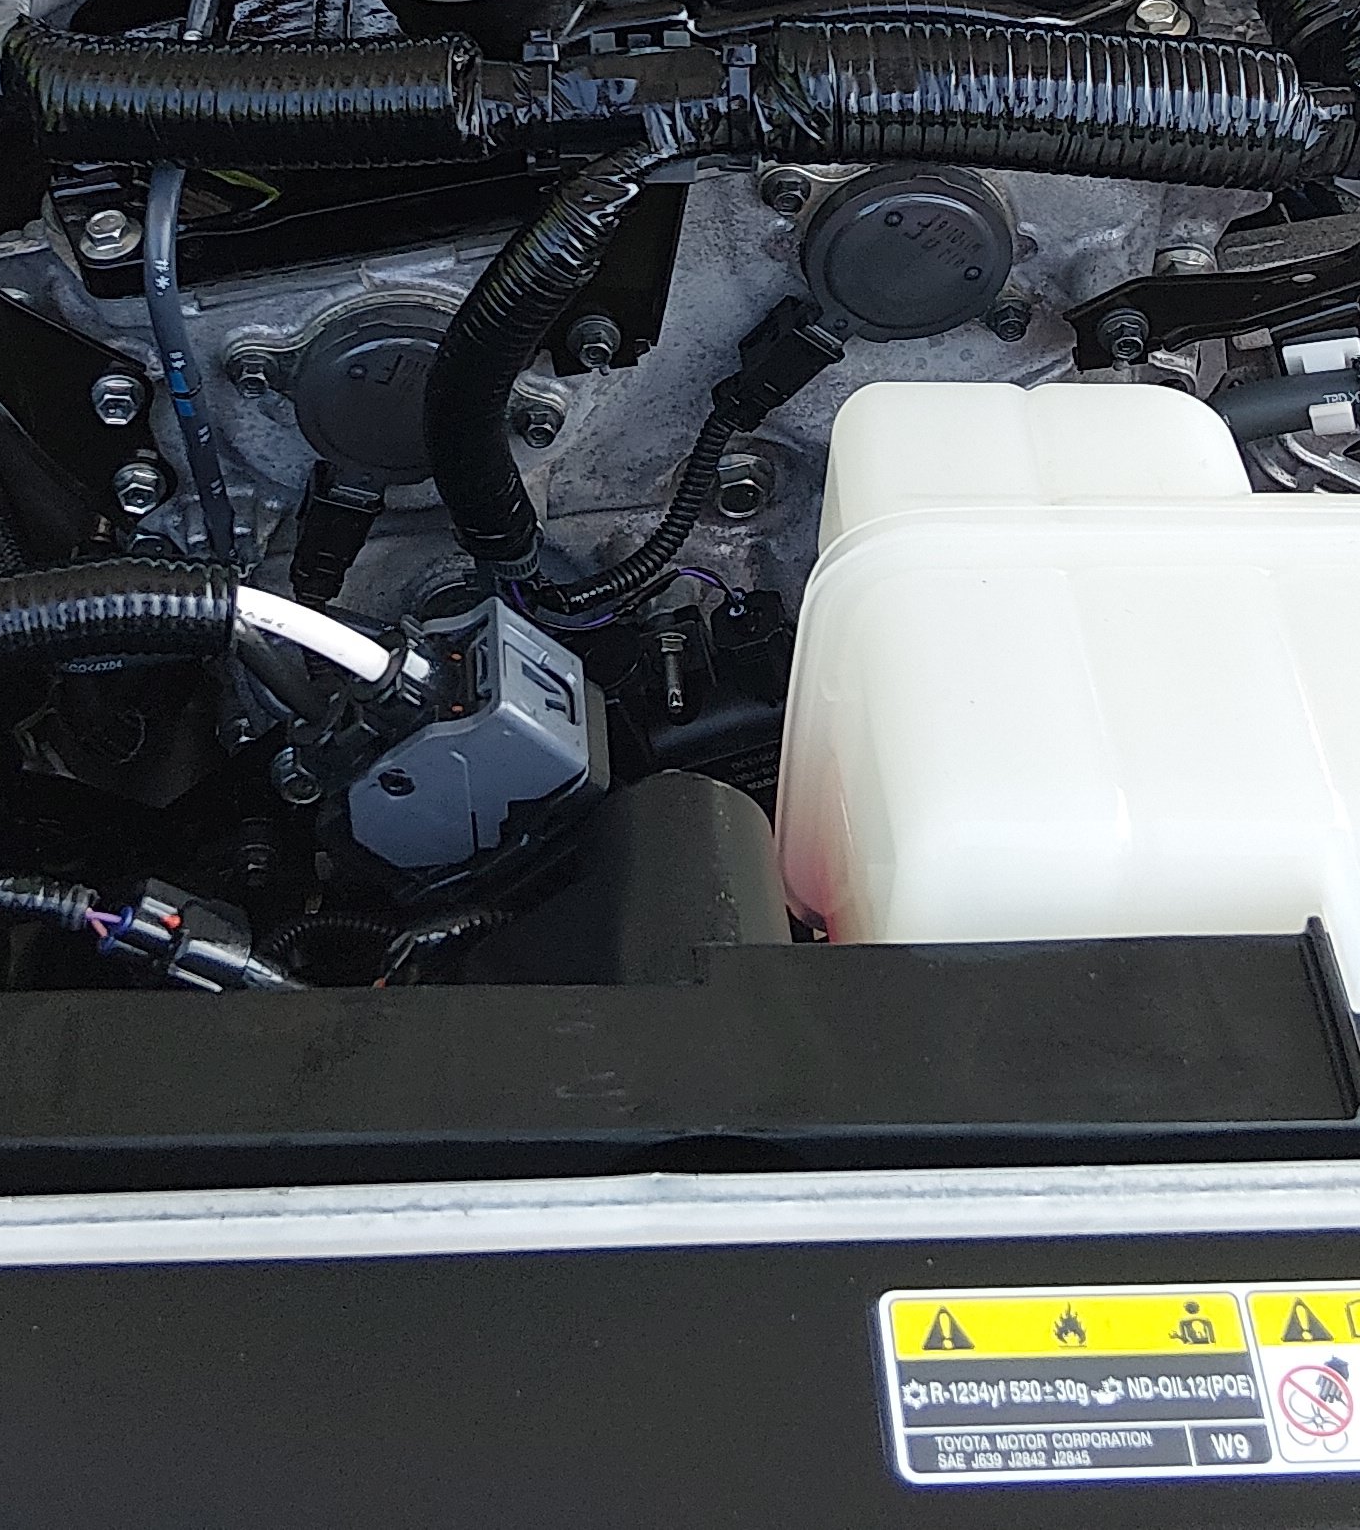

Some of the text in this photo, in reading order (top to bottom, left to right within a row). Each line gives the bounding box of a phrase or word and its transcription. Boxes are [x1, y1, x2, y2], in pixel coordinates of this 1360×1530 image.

[929, 1379, 1007, 1408] R-1234yf
[935, 1430, 1154, 1452] TOYOTA MOTOR CORPORATION
[1210, 1432, 1253, 1461] W9
[937, 1449, 1093, 1469] SAE J639 J2842 J2845
